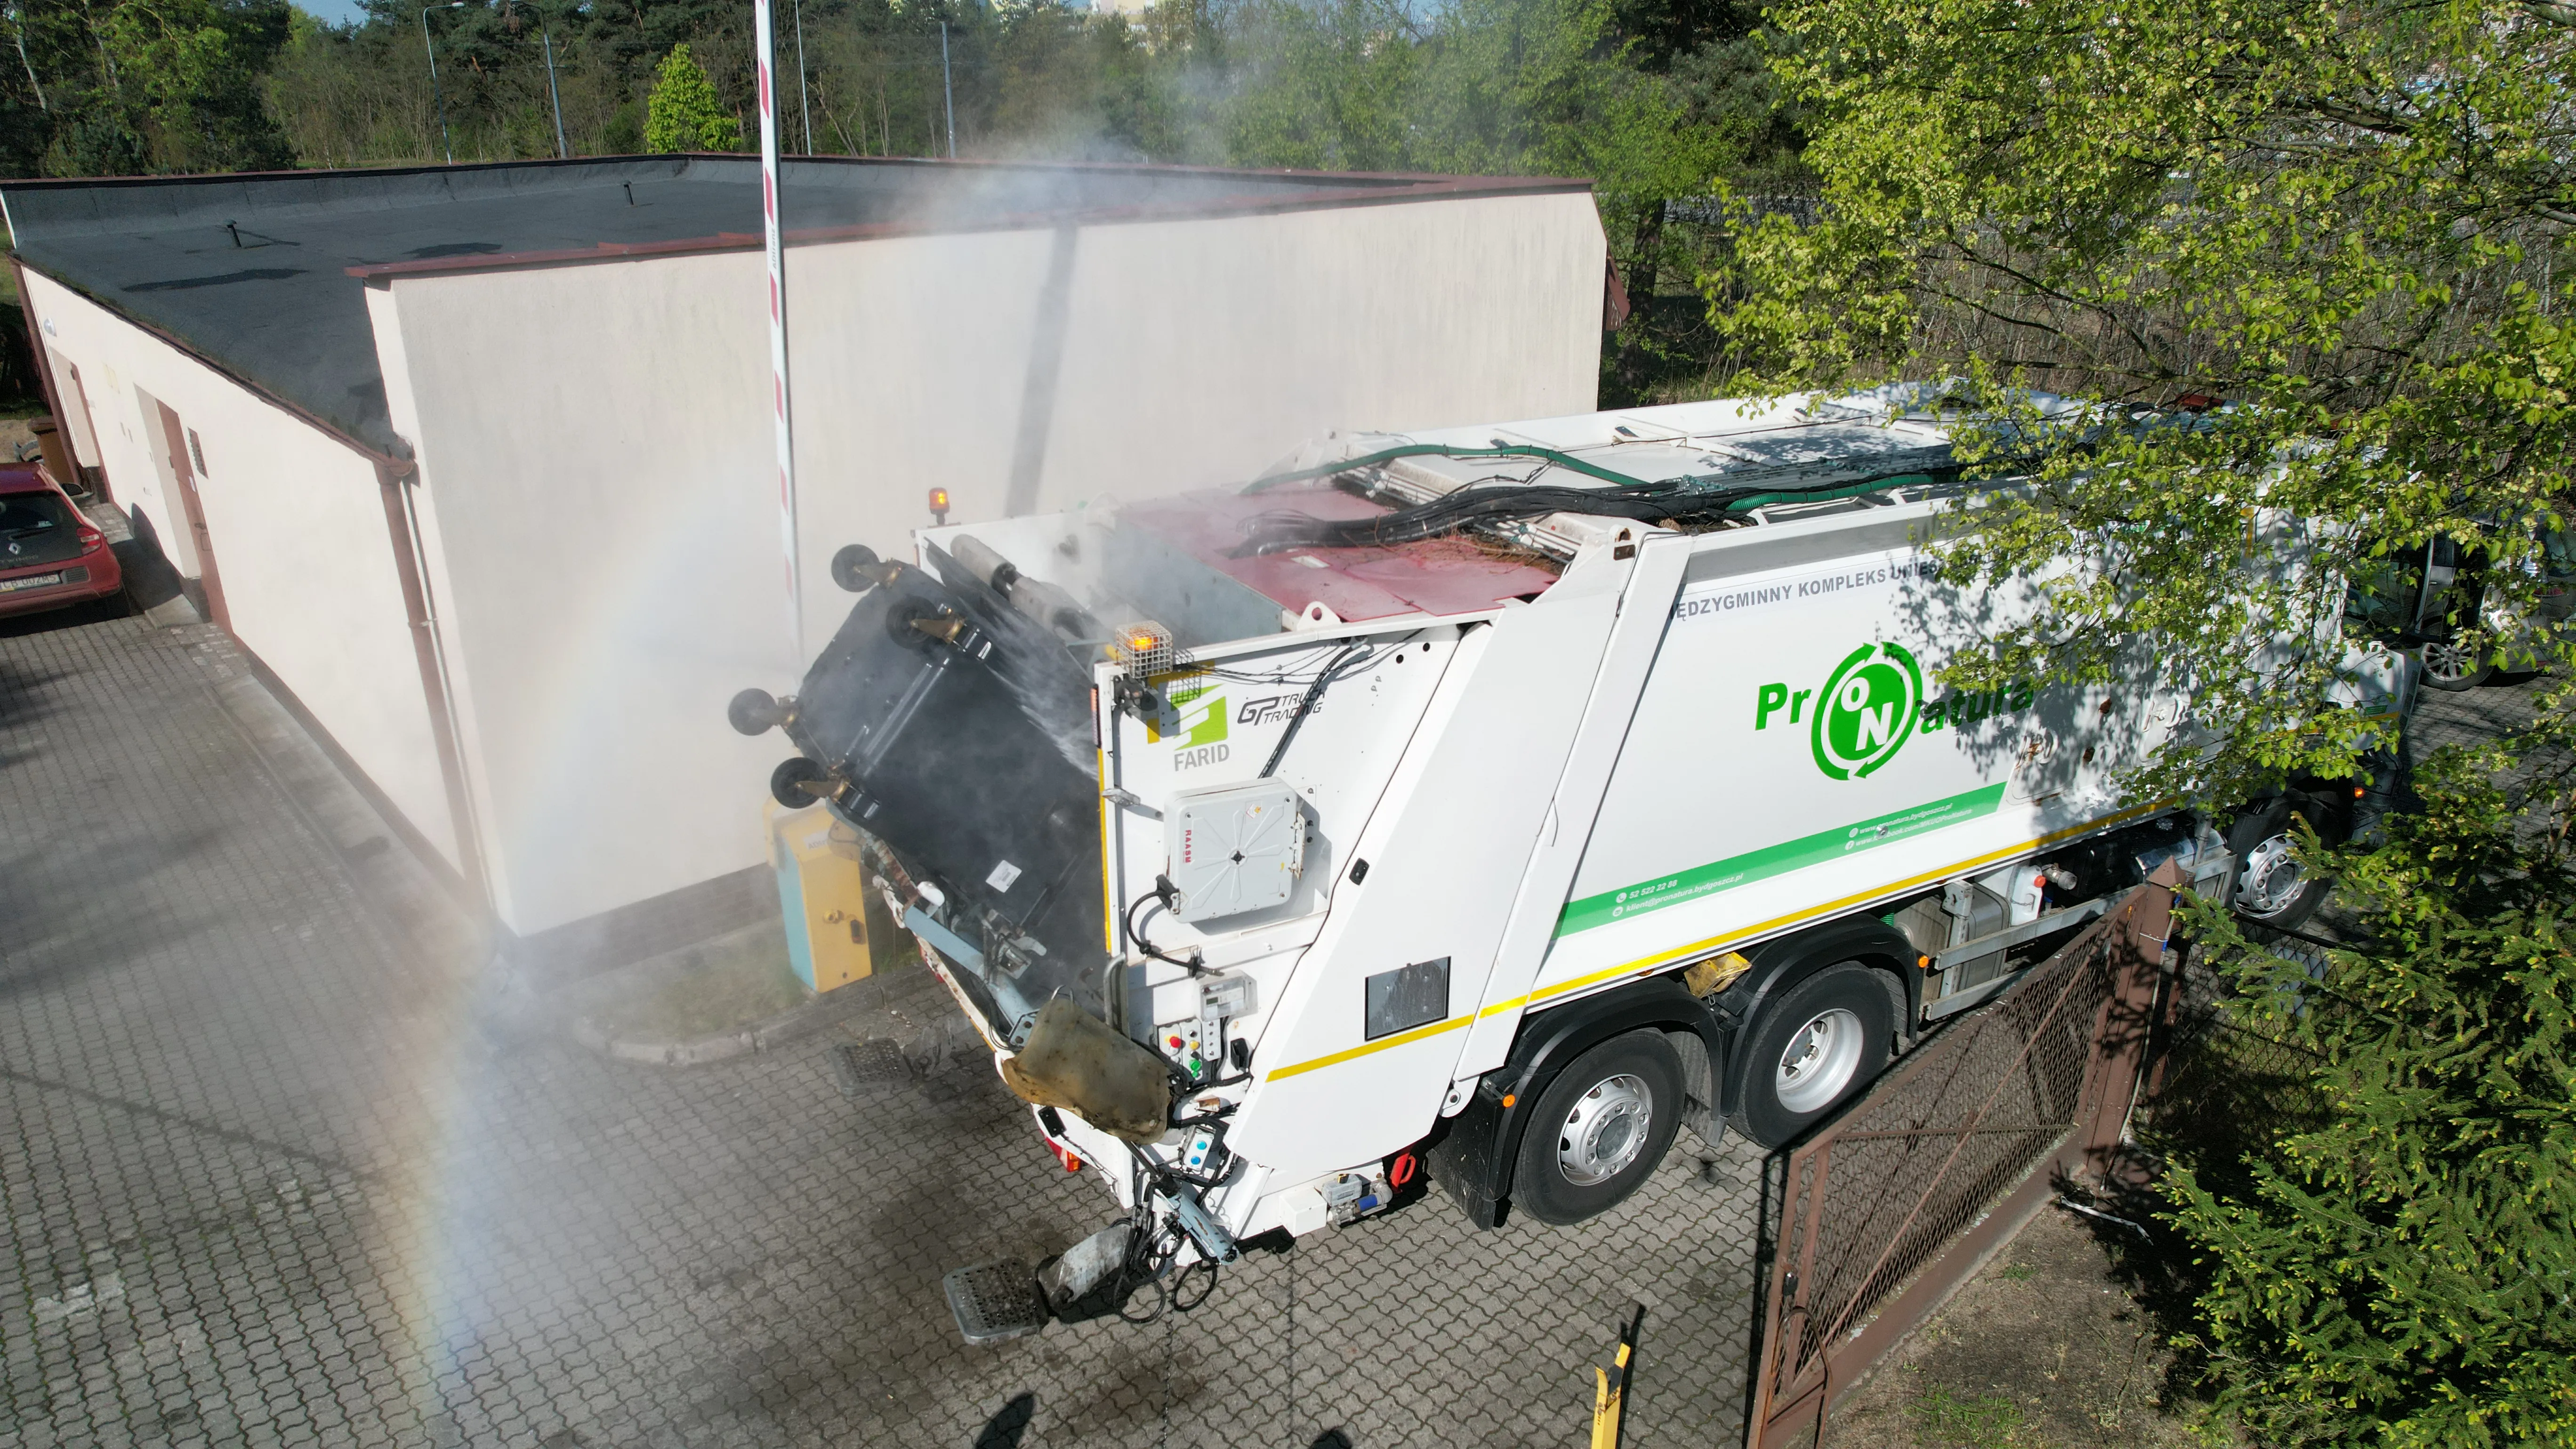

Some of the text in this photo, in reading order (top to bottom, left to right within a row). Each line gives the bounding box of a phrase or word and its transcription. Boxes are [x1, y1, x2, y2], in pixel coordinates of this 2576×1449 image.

[1670, 585, 1792, 621] IĘDZYGMINNY
[1798, 568, 1886, 597] KOMPLEKS
[1264, 702, 1323, 724] TRADNG
[1174, 744, 1230, 772] FARID
[1626, 873, 1743, 912] klient@pronatura.bydgoszcz.pl
[1629, 879, 1677, 899] 52 522 22 88
